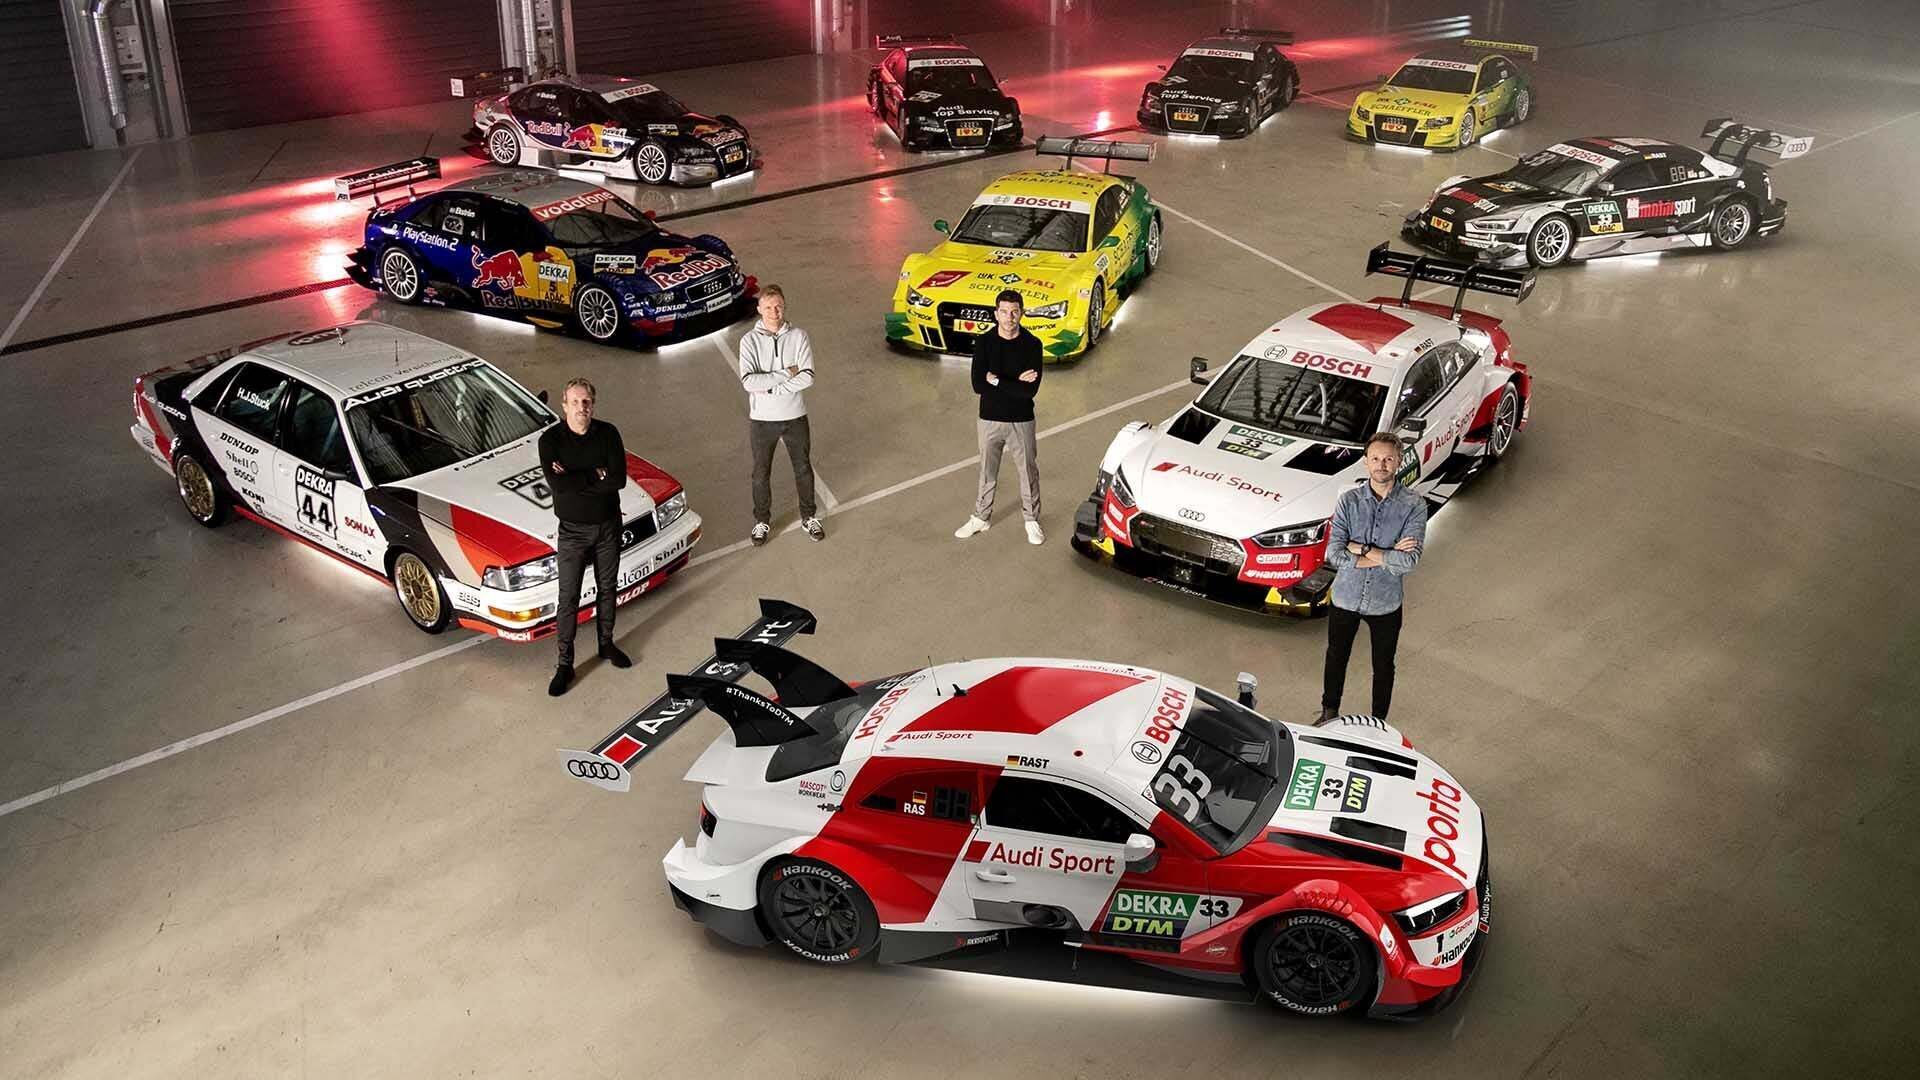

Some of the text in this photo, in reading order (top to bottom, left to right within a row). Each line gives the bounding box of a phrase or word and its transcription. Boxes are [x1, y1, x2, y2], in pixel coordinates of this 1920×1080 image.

[1207, 50, 1243, 58] BOSCH
[1430, 61, 1467, 69] BOSCH
[1181, 94, 1221, 103] Service
[1568, 149, 1605, 163] BOSCH
[535, 190, 615, 218] vodafone
[1014, 197, 1071, 208] BOSCH
[1588, 204, 1615, 213] DEKRA
[403, 227, 448, 249] PlayStation
[539, 264, 568, 279] DEKRA
[650, 254, 733, 290] Red Bull
[655, 303, 687, 314] DUNLOP
[1290, 351, 1372, 379] BOSCH
[344, 360, 486, 412] Audi quattro
[220, 432, 259, 455] DUNLOP
[1237, 428, 1284, 445] DEKRA
[1241, 439, 1263, 448] 33
[1434, 427, 1456, 452] Audi
[225, 450, 249, 468] Shell
[1226, 445, 1260, 457] DTM
[297, 467, 333, 497] DEKRA
[1176, 463, 1283, 502] Audi Sport
[302, 494, 333, 532] 44
[655, 539, 684, 562] Shell
[616, 564, 649, 589] elcon
[726, 687, 795, 726] #ThanksToDTM
[855, 687, 910, 740] BOSCH
[1145, 687, 1188, 745] BOSCH
[935, 731, 974, 740] Sport
[1020, 756, 1049, 769] RAST
[1155, 753, 1213, 823] 33
[1290, 763, 1322, 808] DEKRA
[1322, 778, 1344, 799] 33
[1346, 776, 1368, 810] DTM
[903, 802, 925, 816] RAS
[1415, 777, 1467, 879] porta
[991, 843, 1115, 875] Audi Sport
[1117, 893, 1230, 918] DEKRA 33
[1111, 916, 1174, 935] DTM
